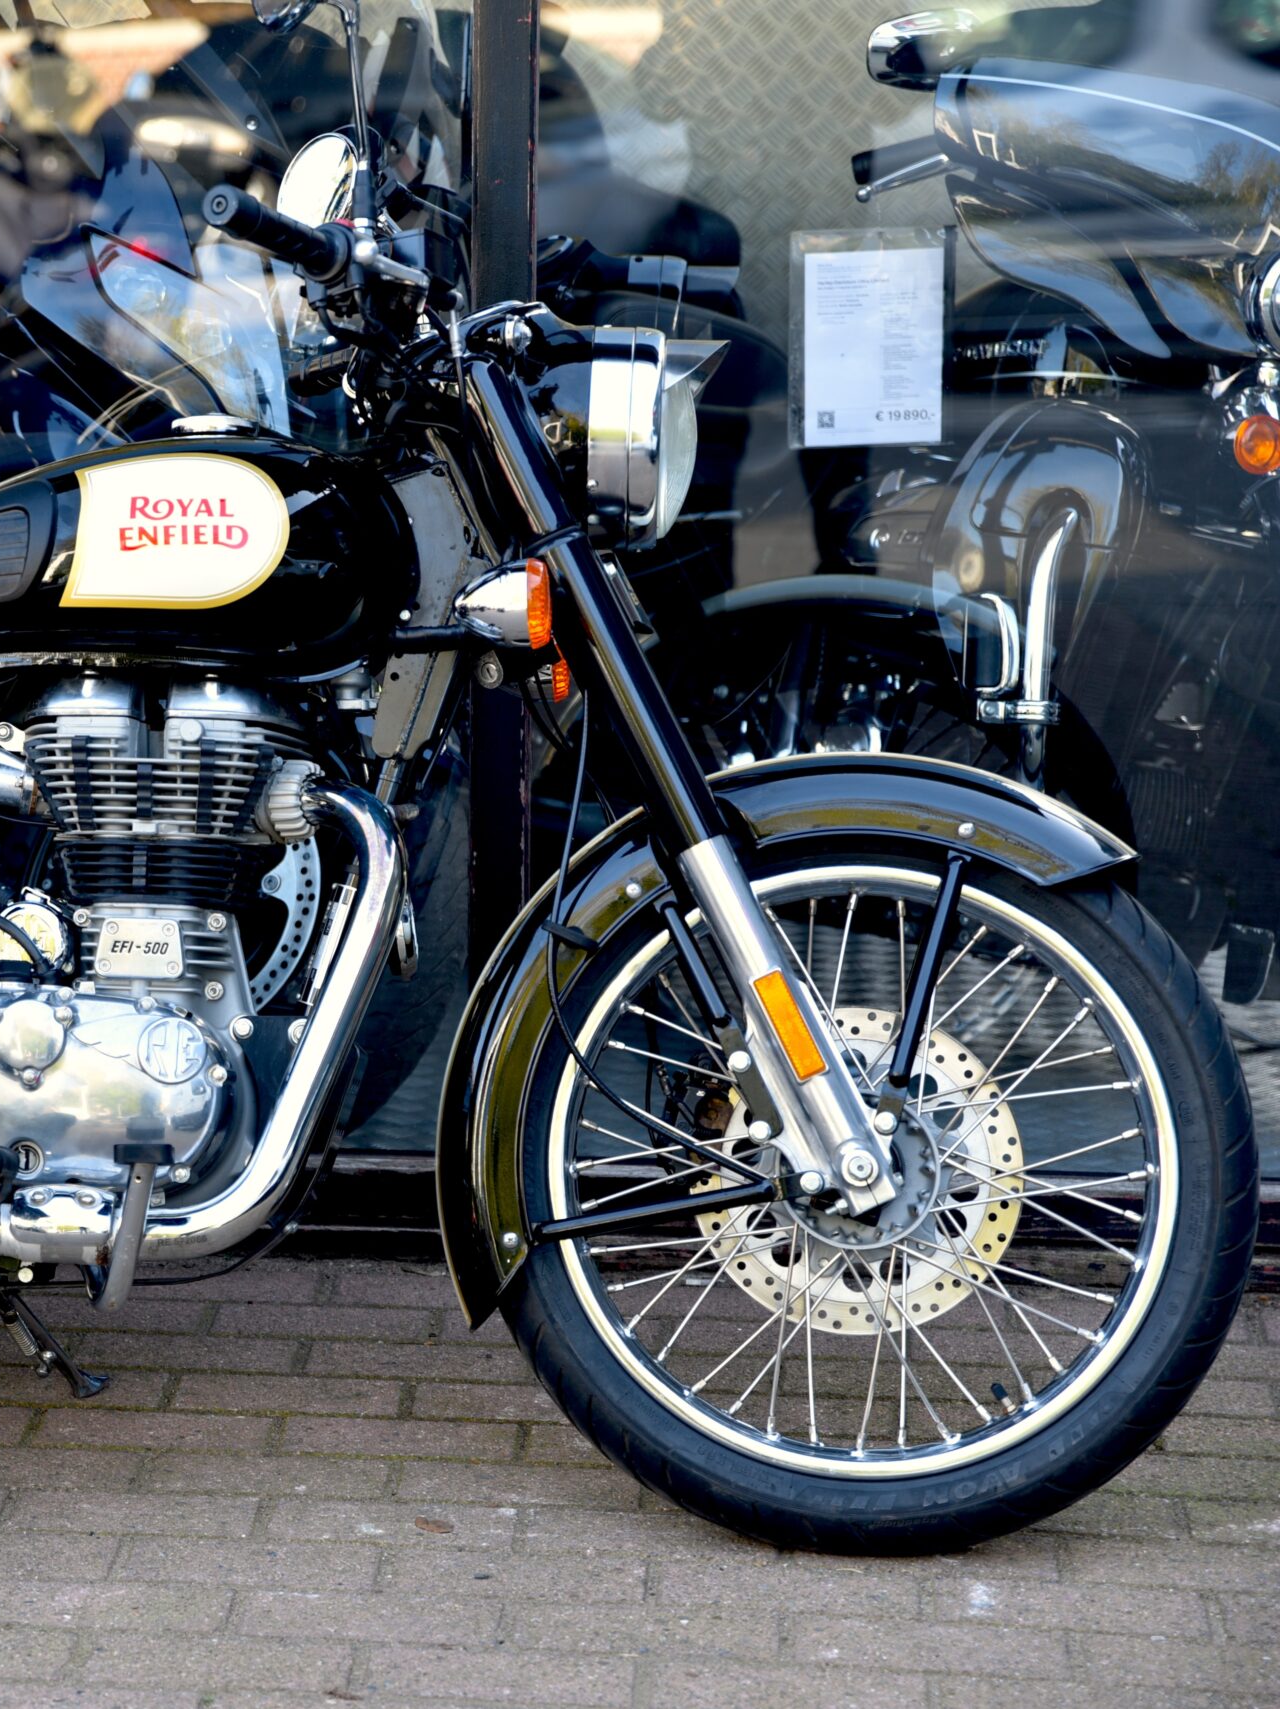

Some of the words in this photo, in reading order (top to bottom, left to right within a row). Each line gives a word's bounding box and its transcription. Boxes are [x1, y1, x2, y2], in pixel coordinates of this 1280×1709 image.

[130, 496, 235, 520] ROYAL
[119, 525, 249, 551] ENFIELD
[922, 1460, 1023, 1507] AVON
